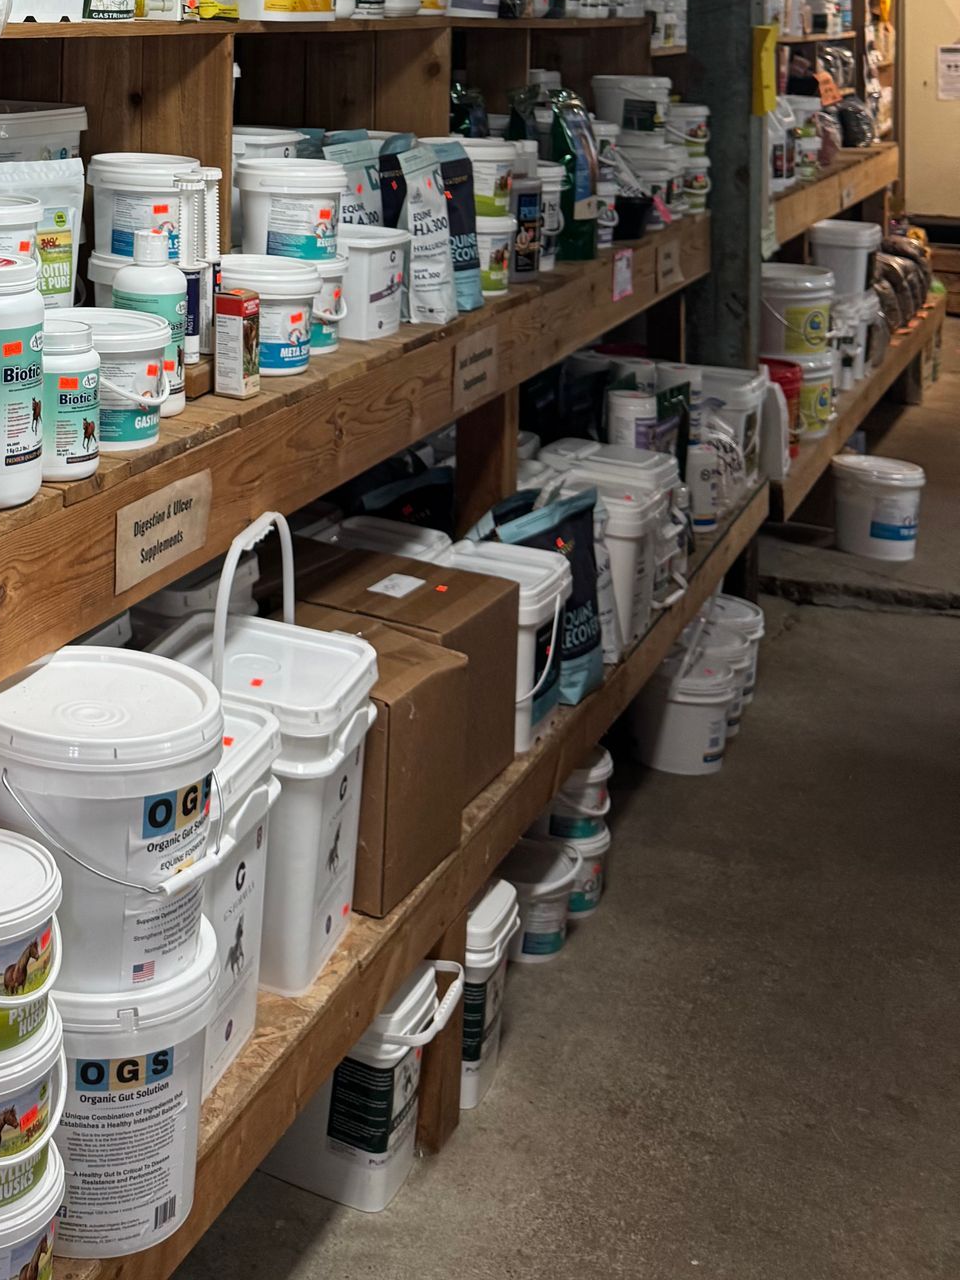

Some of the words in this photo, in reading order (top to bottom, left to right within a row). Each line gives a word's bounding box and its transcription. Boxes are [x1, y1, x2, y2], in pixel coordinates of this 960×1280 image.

[48, 276, 70, 289] PURE
[280, 347, 300, 358] META
[4, 364, 40, 383] Biotic
[59, 393, 92, 405] Biotic
[134, 414, 160, 430] GAST
[134, 511, 166, 537] Digestion
[166, 504, 172, 519] &
[173, 498, 193, 516] Ulcer
[140, 530, 184, 564] Supplements
[146, 829, 180, 854] Organic
[181, 824, 194, 840] Gut
[160, 854, 184, 871] EQUINE
[80, 1050, 170, 1085] OGS
[80, 1093, 117, 1106] Organic
[118, 1092, 134, 1103] Gut
[136, 1081, 170, 1100] Solution
[64, 1112, 90, 1122] Unique
[91, 1108, 134, 1121] Combination
[135, 1106, 142, 1115] of
[143, 1097, 174, 1115] Ingredients
[174, 1090, 184, 1102] that
[60, 1120, 100, 1129] Establishes
[107, 1118, 132, 1129] Healthy
[133, 1110, 161, 1126] Intestinal
[79, 1170, 102, 1179] Healthy
[122, 1166, 144, 1176] Critical
